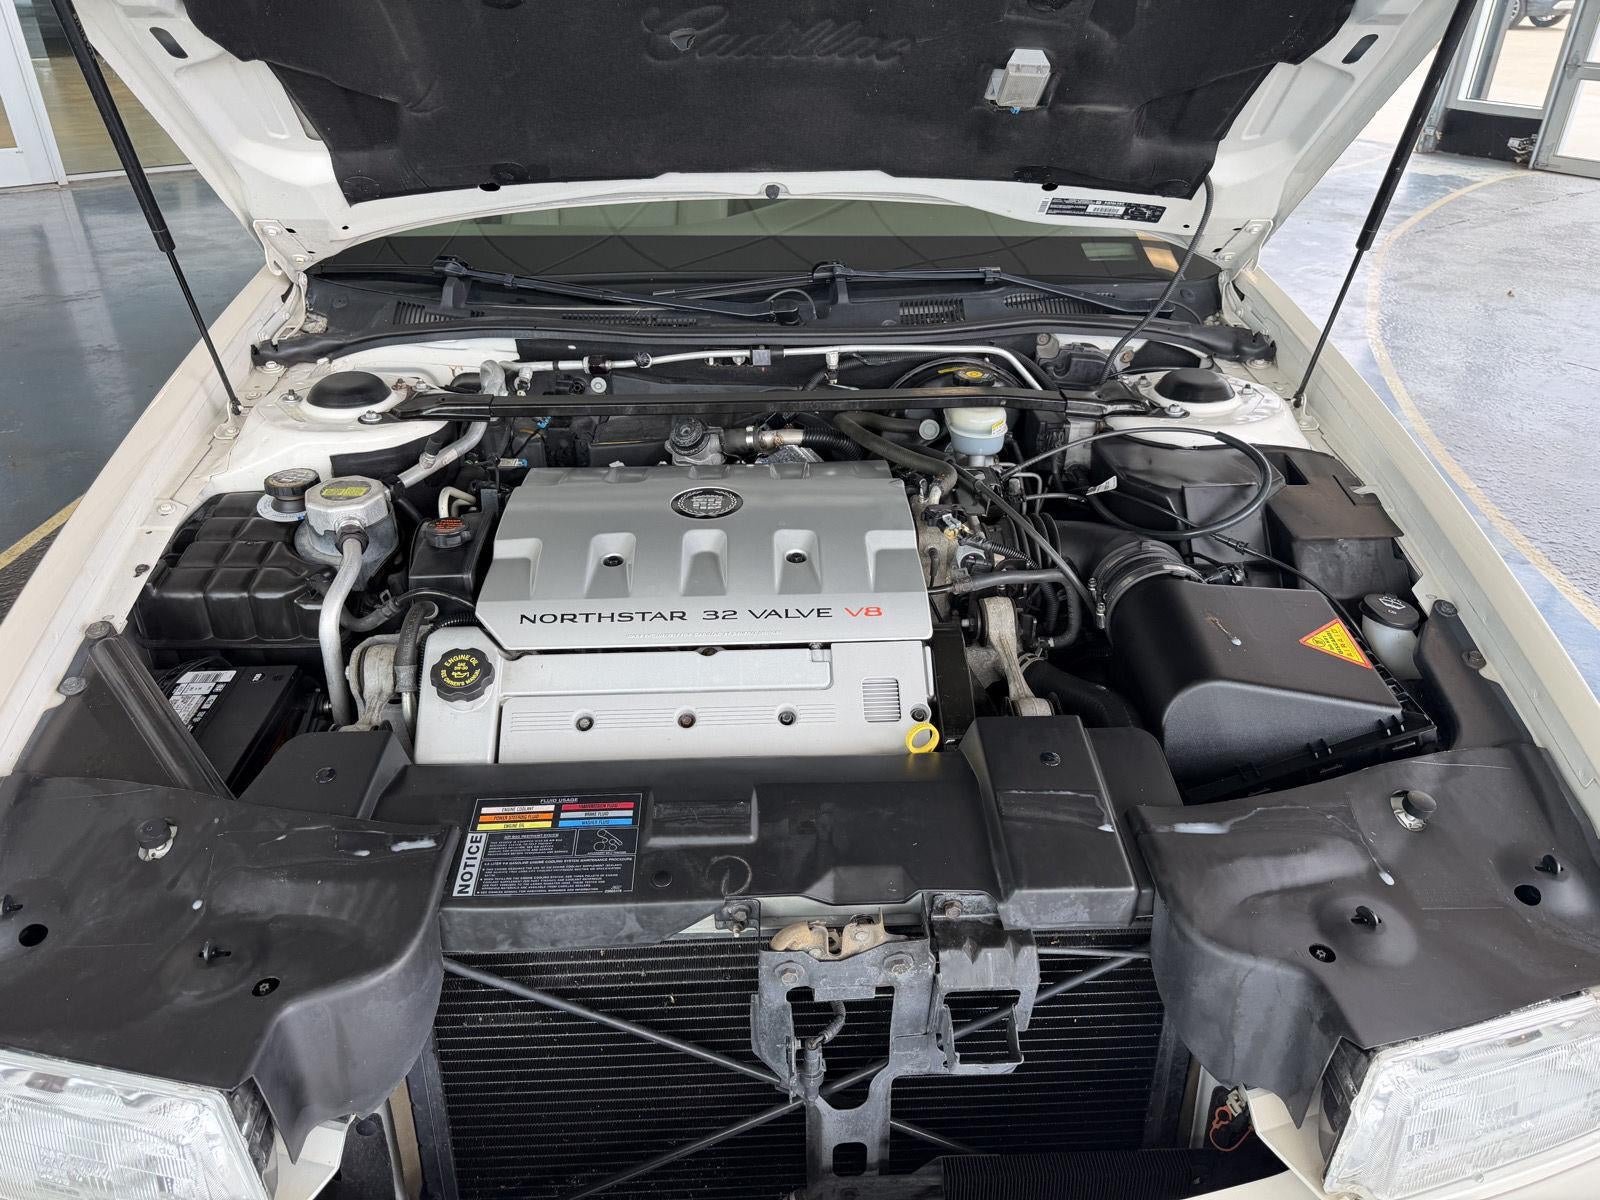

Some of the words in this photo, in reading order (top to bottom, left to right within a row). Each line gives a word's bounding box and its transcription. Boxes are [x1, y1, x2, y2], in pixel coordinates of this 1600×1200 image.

[519, 610, 688, 625] NORTHSTAR
[702, 609, 738, 620] 32
[748, 607, 833, 619] VALVE
[844, 606, 883, 618] V8
[444, 654, 471, 667] ENGINE
[469, 657, 479, 667] OIL
[457, 835, 483, 894] NOTICE
